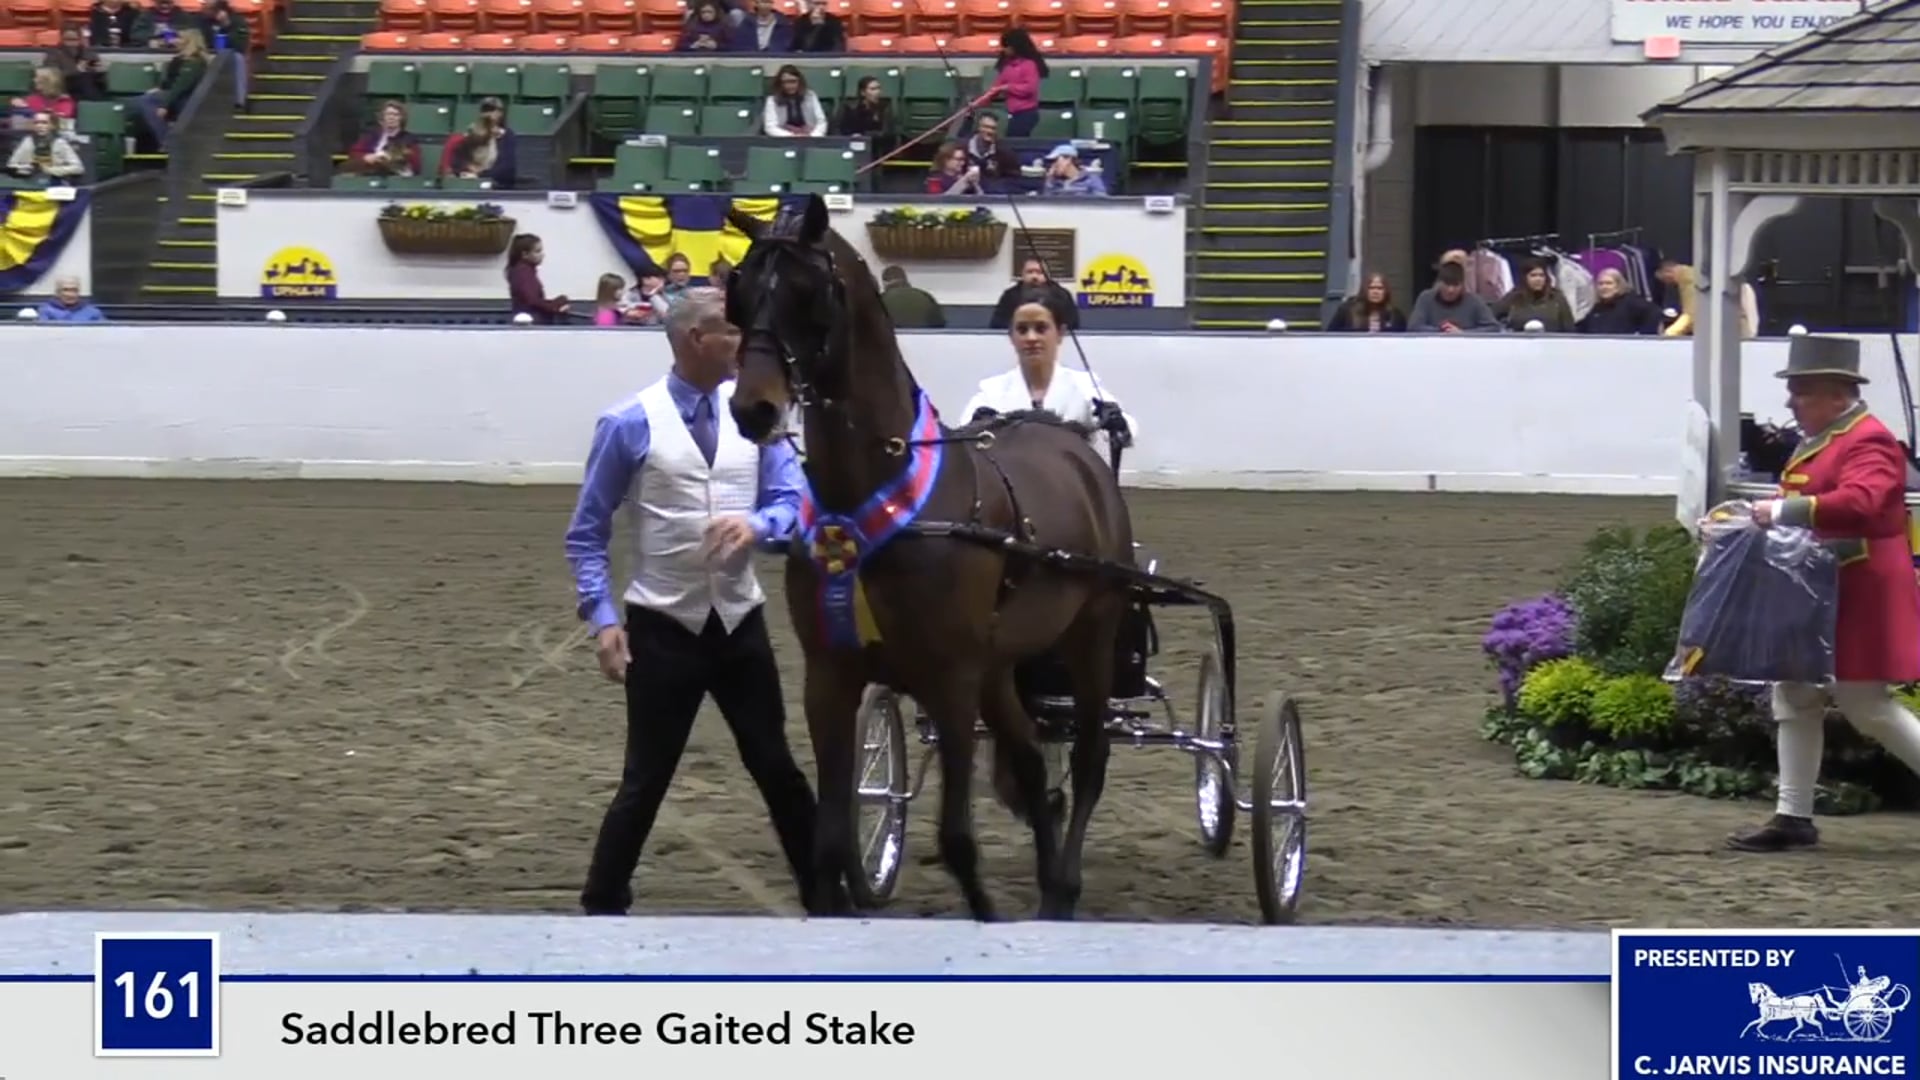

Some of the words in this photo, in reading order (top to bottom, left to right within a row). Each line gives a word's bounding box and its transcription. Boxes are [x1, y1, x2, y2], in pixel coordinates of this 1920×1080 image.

[1666, 15, 1692, 28] WE
[1698, 15, 1743, 28] HOPE
[1752, 15, 1785, 28] YOU
